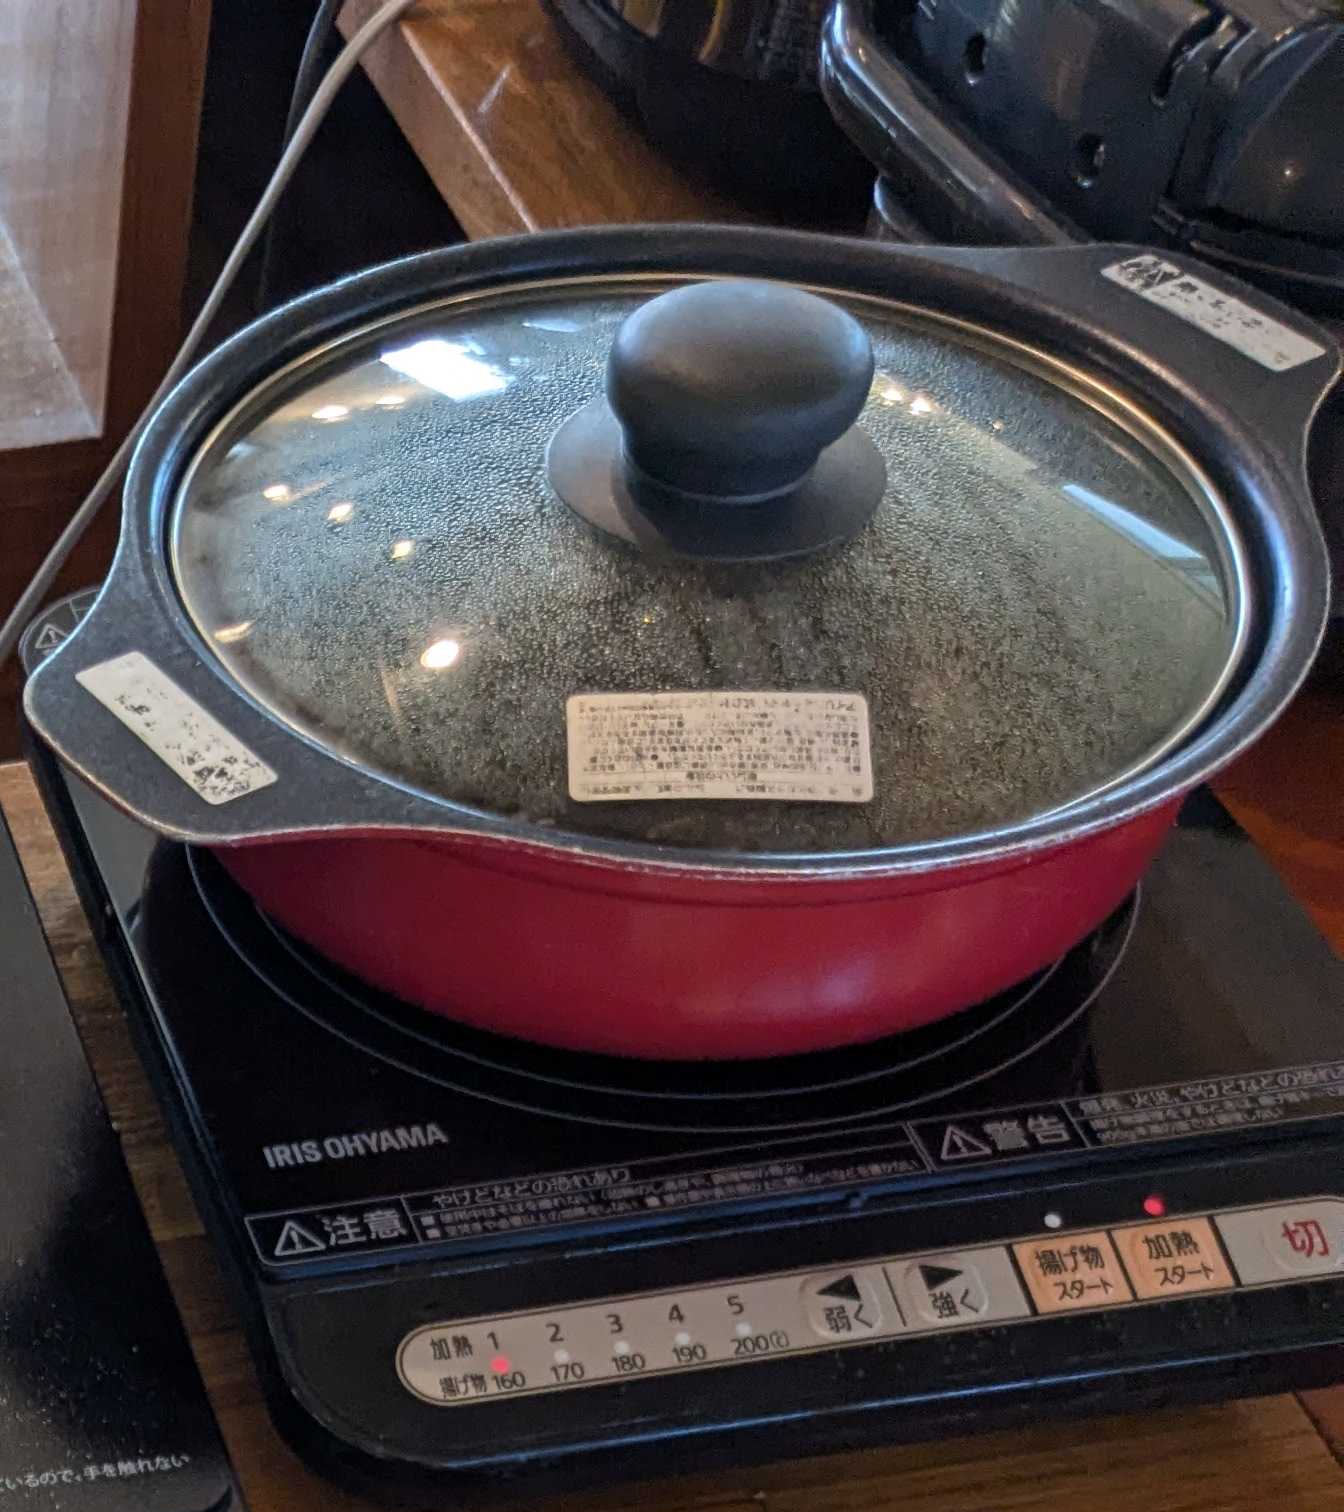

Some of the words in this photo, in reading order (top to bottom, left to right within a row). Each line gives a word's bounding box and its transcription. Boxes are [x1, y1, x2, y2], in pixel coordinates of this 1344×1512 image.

[263, 1140, 322, 1169] IRIS
[327, 1122, 449, 1161] OHYAMA
[982, 1115, 1072, 1152] 警告
[322, 1207, 408, 1248] 注意
[1281, 1219, 1331, 1259] 切
[1034, 1246, 1105, 1276] 揚げ物
[1141, 1232, 1201, 1260] 加熱
[1053, 1277, 1113, 1302] スタート
[1154, 1263, 1216, 1287] スタート
[824, 1302, 874, 1334] 弱く
[930, 1287, 980, 1320] 強く
[430, 1337, 474, 1361] 加熱
[486, 1331, 501, 1351] 1
[546, 1323, 565, 1343] 2
[605, 1314, 624, 1335] 3
[667, 1303, 685, 1324] 4
[727, 1295, 744, 1316] 5
[492, 1373, 527, 1391] 160
[550, 1362, 586, 1382] 170
[611, 1353, 647, 1373] 180
[671, 1343, 708, 1363] 190
